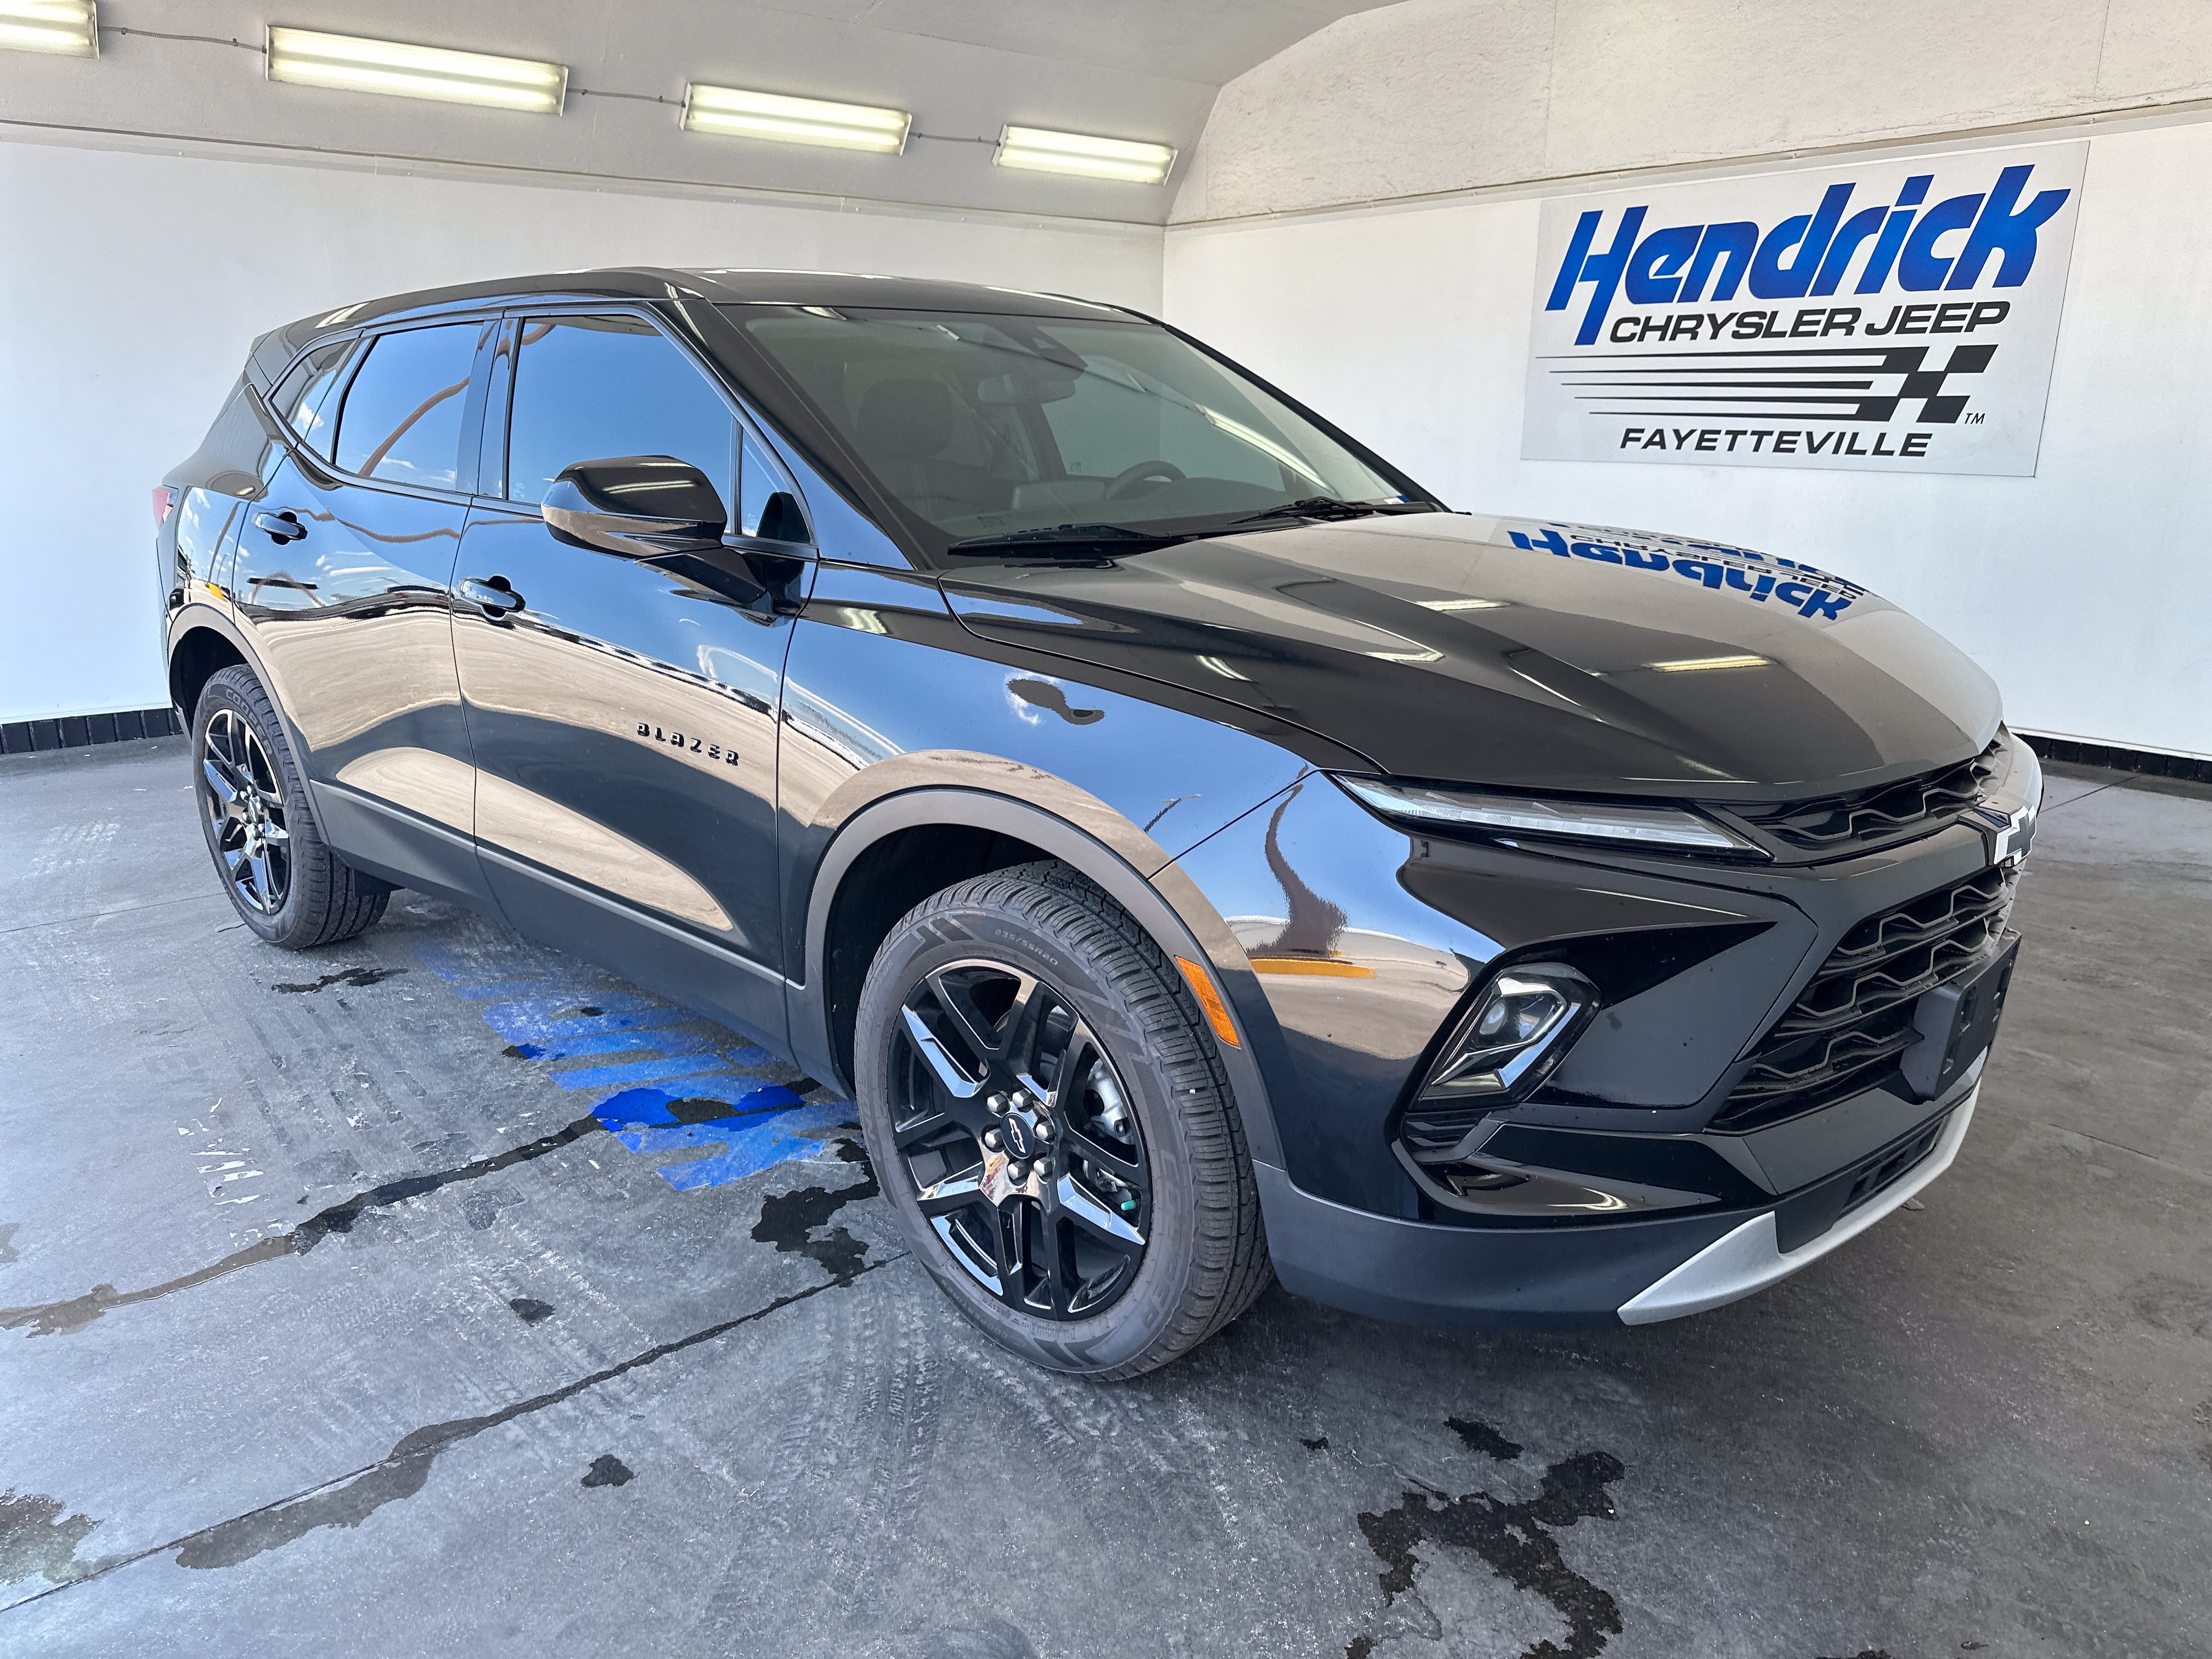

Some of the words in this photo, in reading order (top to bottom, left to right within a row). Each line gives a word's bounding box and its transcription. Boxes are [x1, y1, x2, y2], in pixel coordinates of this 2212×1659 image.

[1545, 165, 2070, 346] Hendrick
[1610, 307, 1862, 343] CHRYSLER
[1864, 301, 2011, 336] JEEP
[1964, 413, 1985, 424] TM
[1620, 428, 1933, 457] FAYETTEVILLE
[225, 688, 273, 755] COOPER
[636, 722, 740, 766] BLAZER
[995, 928, 1059, 966] 235/55R20
